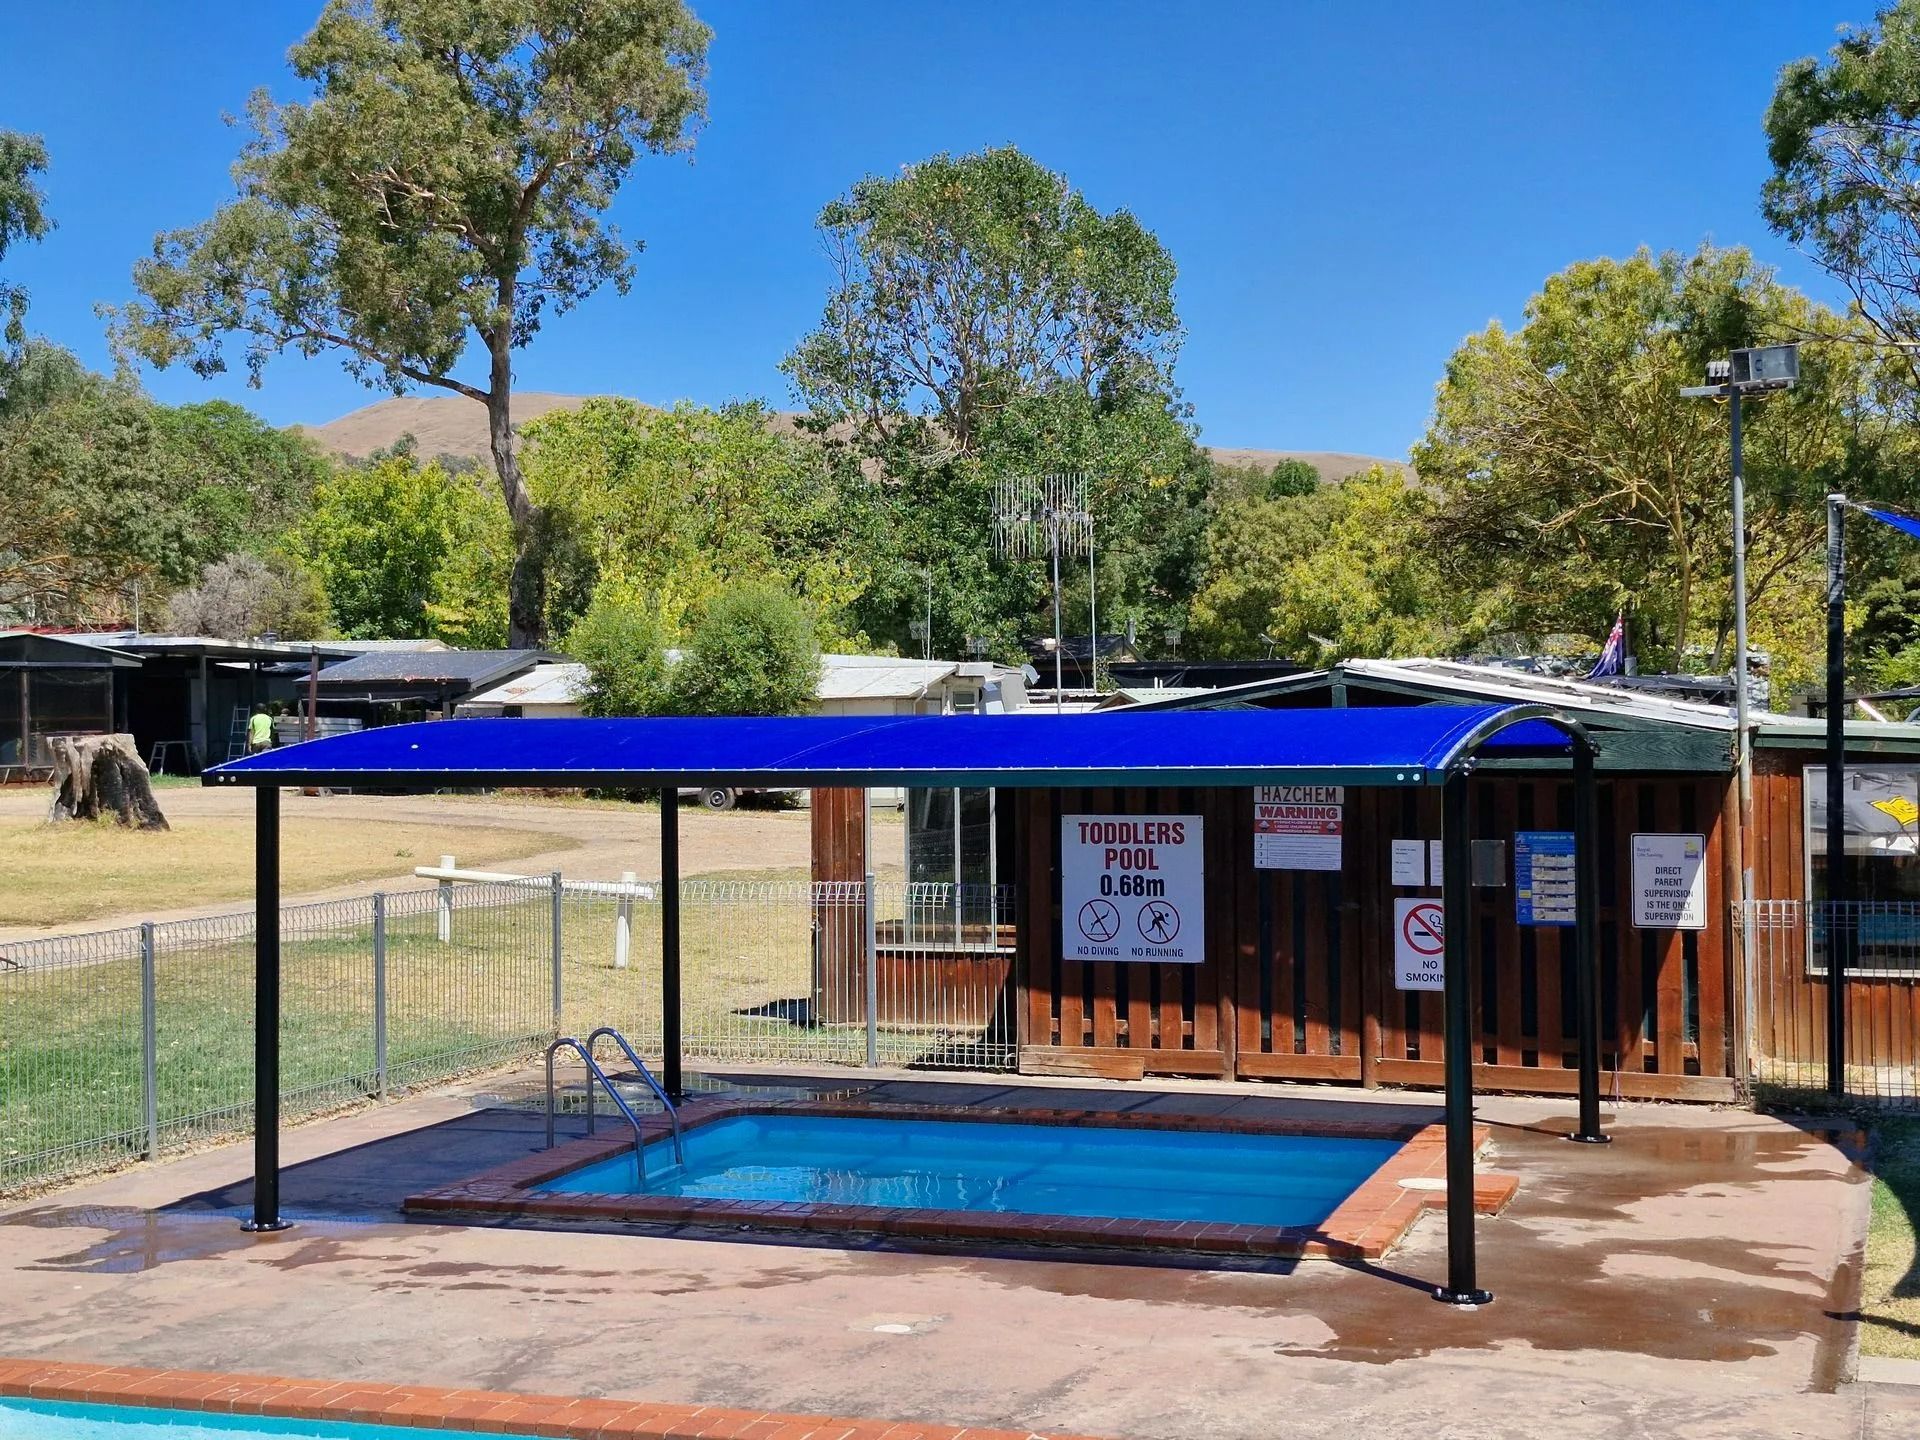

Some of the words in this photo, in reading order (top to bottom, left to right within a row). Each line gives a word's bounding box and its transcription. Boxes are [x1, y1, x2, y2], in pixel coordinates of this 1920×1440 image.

[1261, 786, 1337, 803] HAZCHEM
[1259, 806, 1338, 820] WARNING
[1078, 822, 1185, 845] TODDLERS
[1105, 848, 1159, 871] POOL
[1655, 867, 1682, 875] DIRECT
[1100, 875, 1165, 897] 0.68m
[1654, 878, 1683, 886] PARENT
[1644, 889, 1693, 898] SUPERVISION
[1647, 901, 1654, 909] IS
[1657, 901, 1670, 909] THE
[1672, 901, 1691, 910] ONLY
[1644, 912, 1694, 920] SUPERVISION
[1077, 946, 1089, 955] NO
[1091, 946, 1119, 956] DIVING
[1131, 947, 1143, 956] NO
[1145, 947, 1183, 957] RUNNING
[1422, 960, 1438, 970] NO
[1405, 973, 1444, 983] SMOKIN
